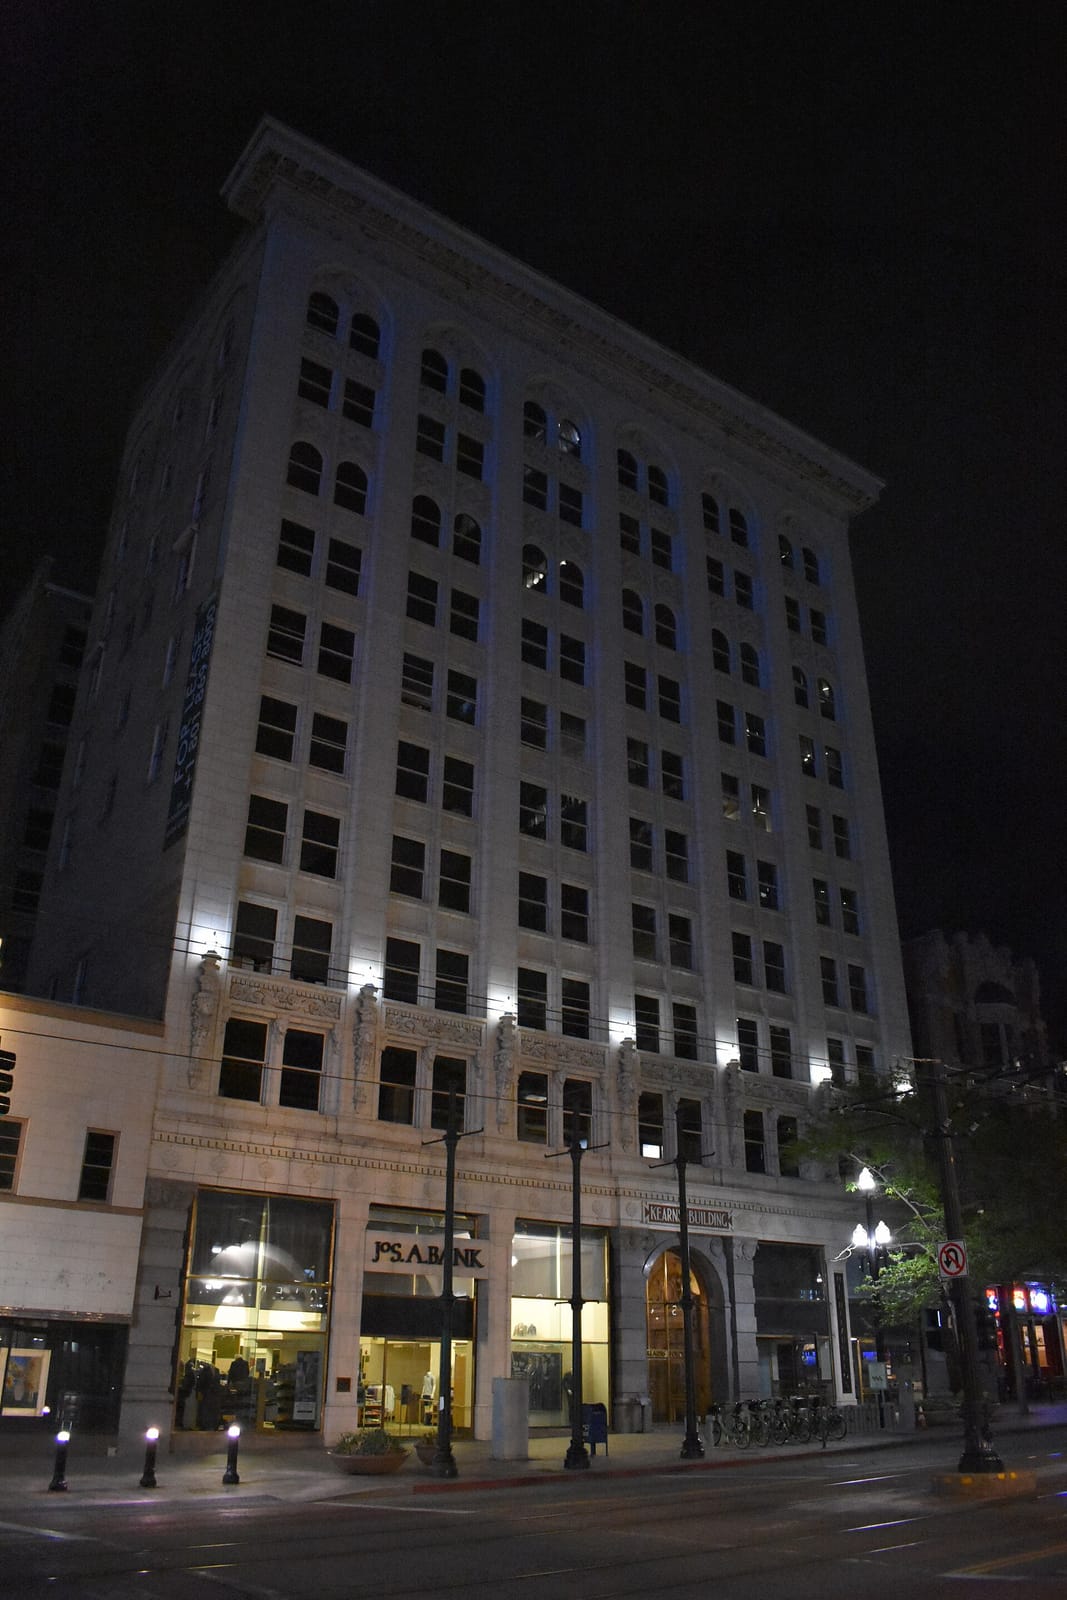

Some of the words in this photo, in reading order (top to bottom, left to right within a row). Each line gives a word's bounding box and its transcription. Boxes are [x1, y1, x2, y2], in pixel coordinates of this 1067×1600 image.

[174, 719, 190, 784] FOR
[184, 628, 203, 713] LEASE
[688, 1210, 728, 1228] BUILDING
